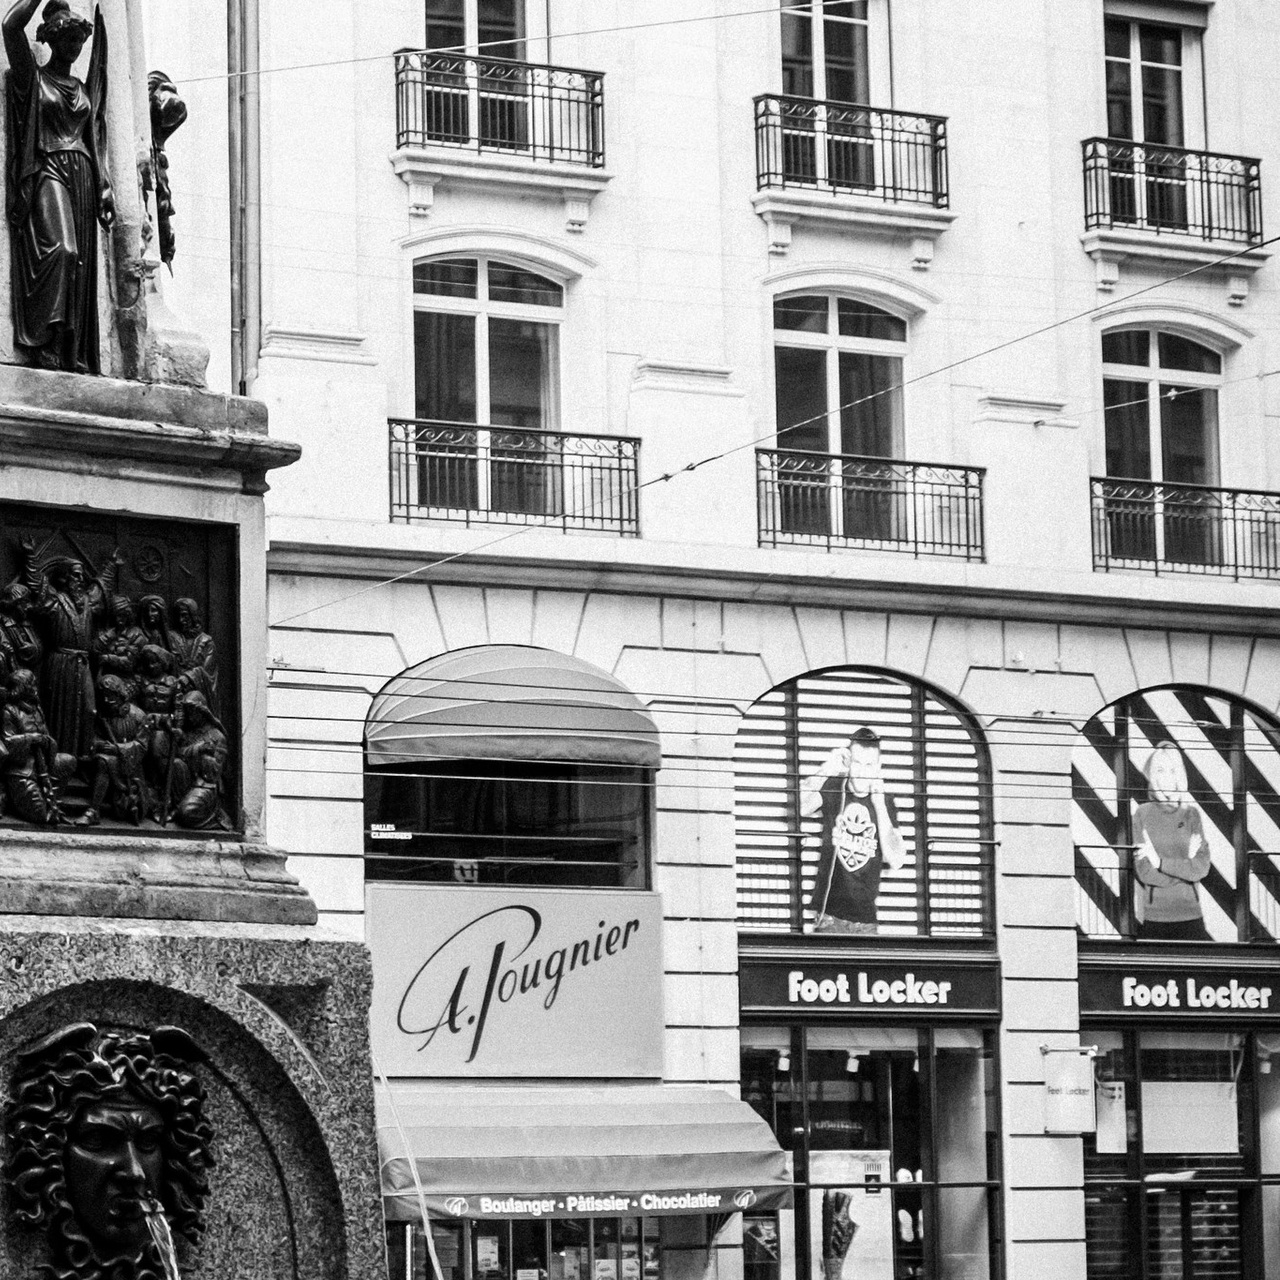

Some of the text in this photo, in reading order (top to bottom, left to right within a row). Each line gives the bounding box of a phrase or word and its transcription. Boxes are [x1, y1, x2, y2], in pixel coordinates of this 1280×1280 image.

[460, 905, 640, 1063] Pougnier
[788, 970, 952, 1004] Foot Locker
[1122, 976, 1273, 1009] Foot Locker
[479, 1192, 722, 1216] Boulanger Pâtissier Chocolatier
